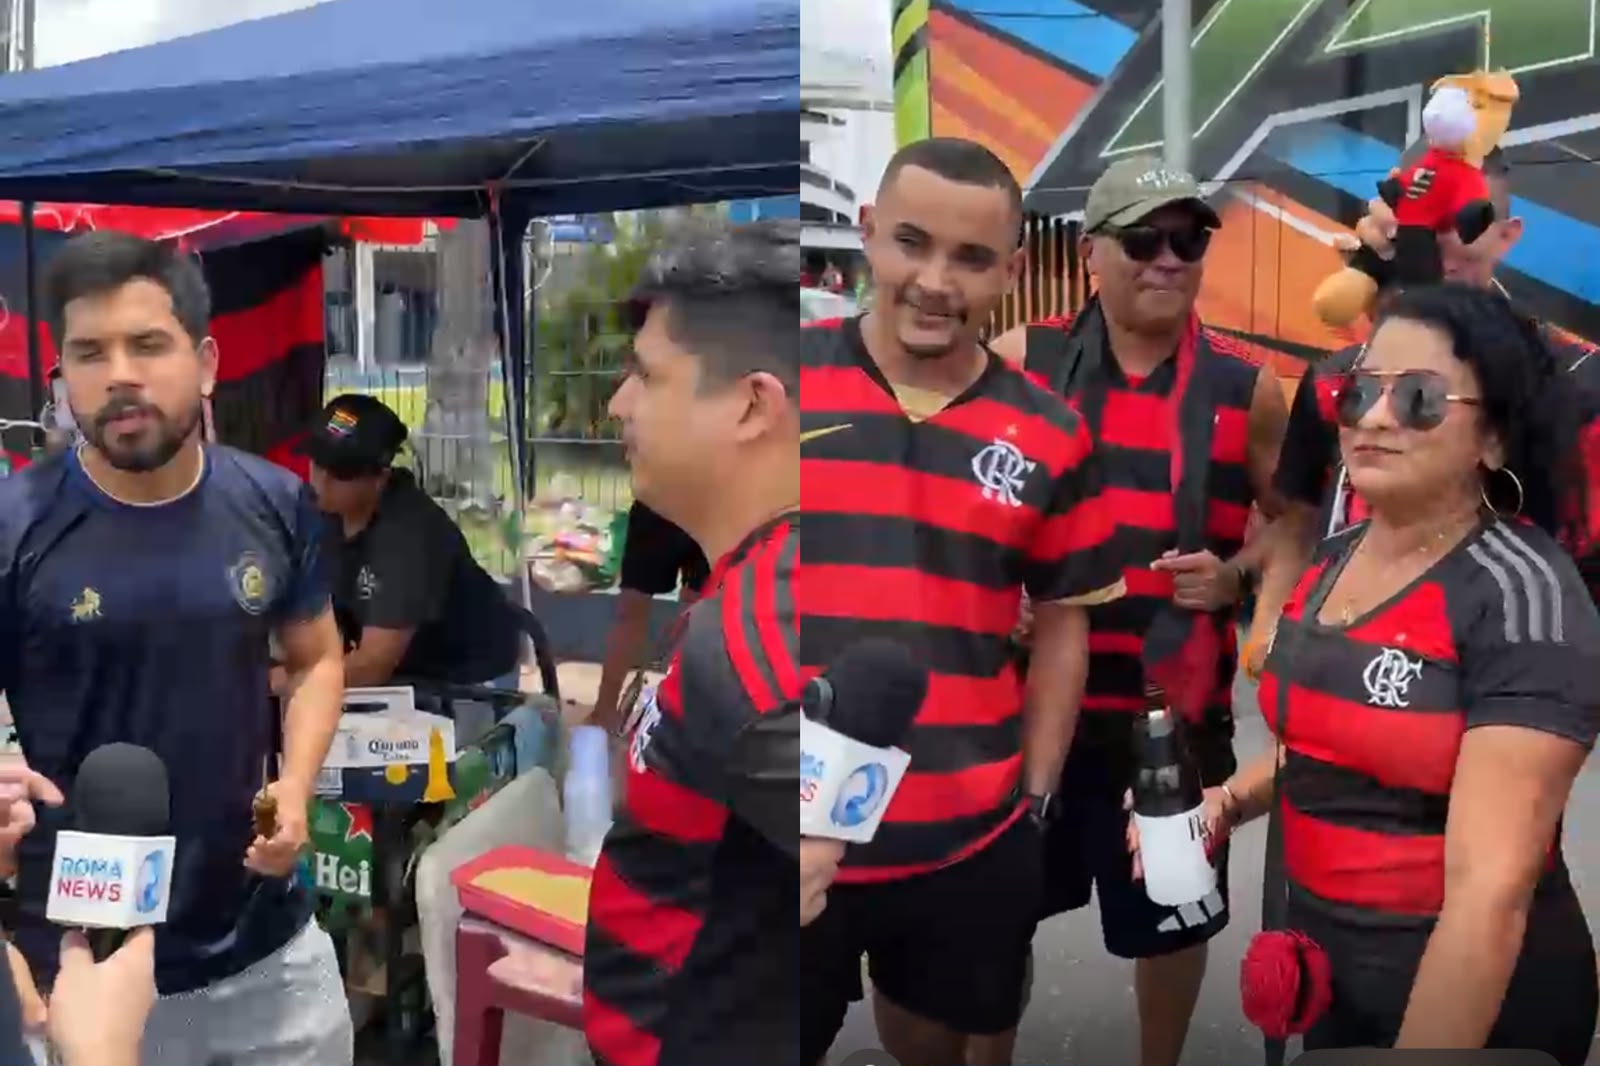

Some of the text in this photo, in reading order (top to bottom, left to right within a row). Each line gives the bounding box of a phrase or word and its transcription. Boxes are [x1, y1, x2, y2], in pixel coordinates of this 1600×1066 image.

[60, 856, 122, 879] ROMA
[315, 852, 372, 897] Hei
[57, 876, 122, 902] NEWS
